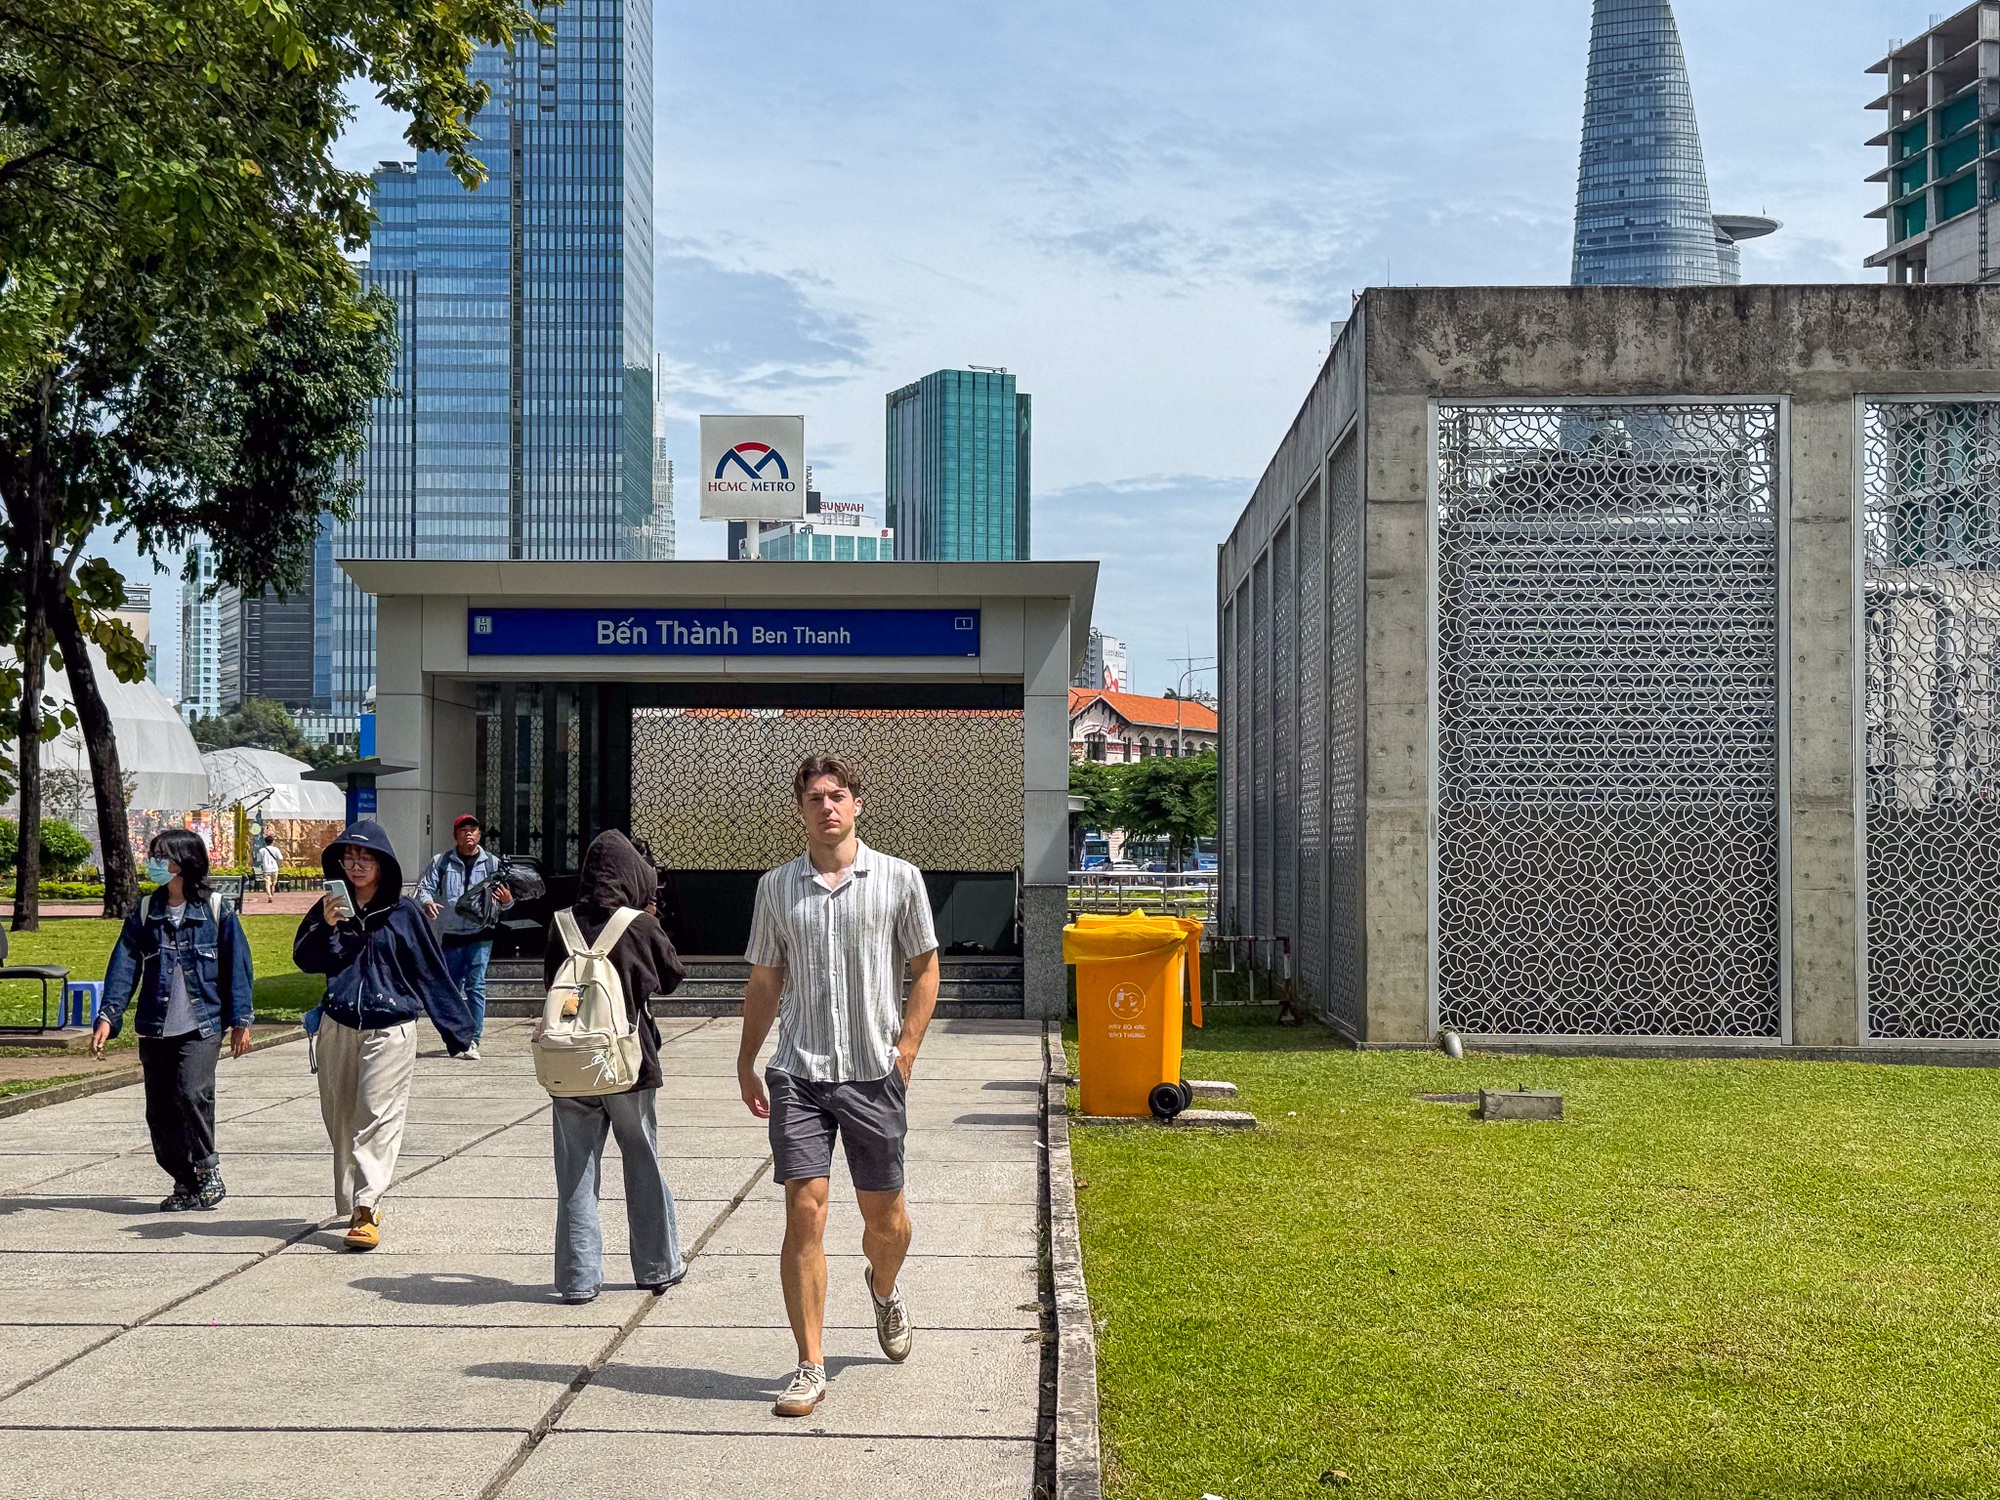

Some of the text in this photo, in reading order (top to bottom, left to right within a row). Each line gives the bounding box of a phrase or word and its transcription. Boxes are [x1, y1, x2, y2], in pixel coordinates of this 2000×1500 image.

[708, 481, 796, 492] HCMC METRO
[820, 501, 864, 513] SUNWAH
[597, 617, 851, 645] Bến Thành Ben Thanh
